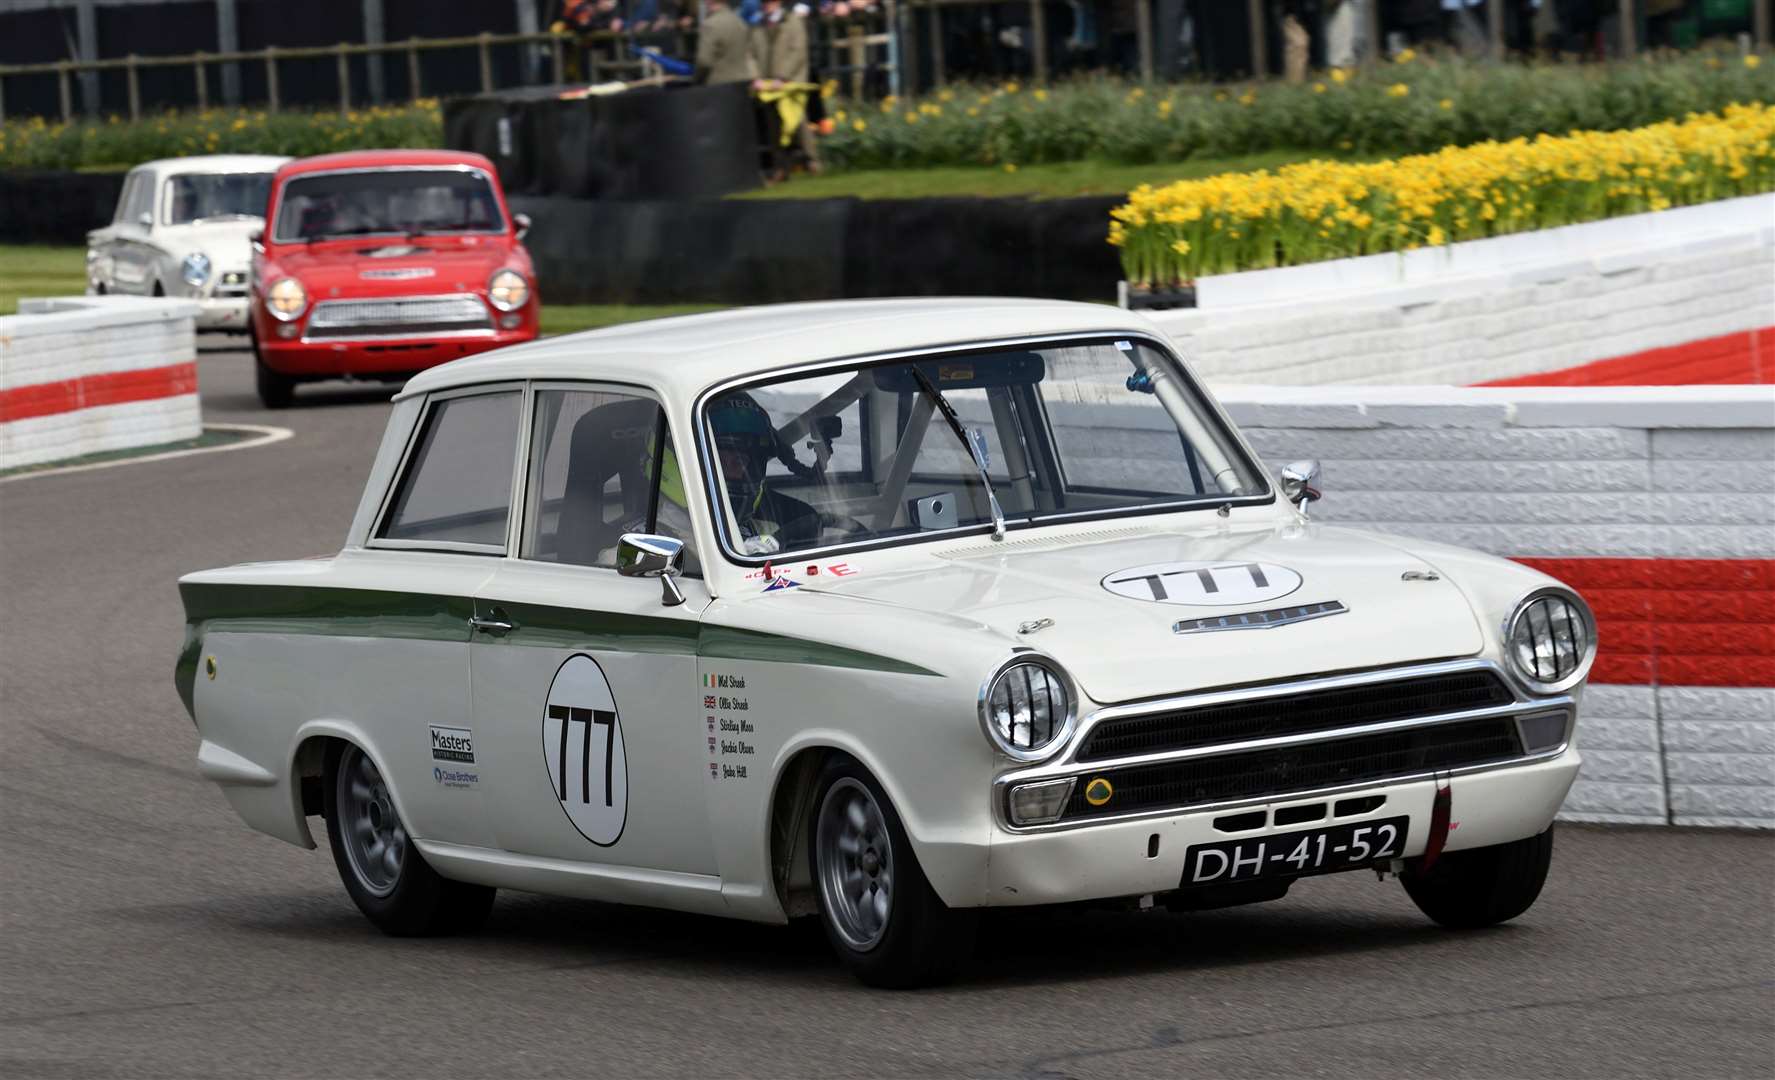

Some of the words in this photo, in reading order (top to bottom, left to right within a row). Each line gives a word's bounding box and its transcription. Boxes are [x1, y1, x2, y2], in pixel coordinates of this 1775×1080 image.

[1110, 563, 1270, 601] 777
[432, 730, 472, 751] Masters
[548, 704, 616, 807] 777
[1193, 823, 1398, 883] DH-41-52
